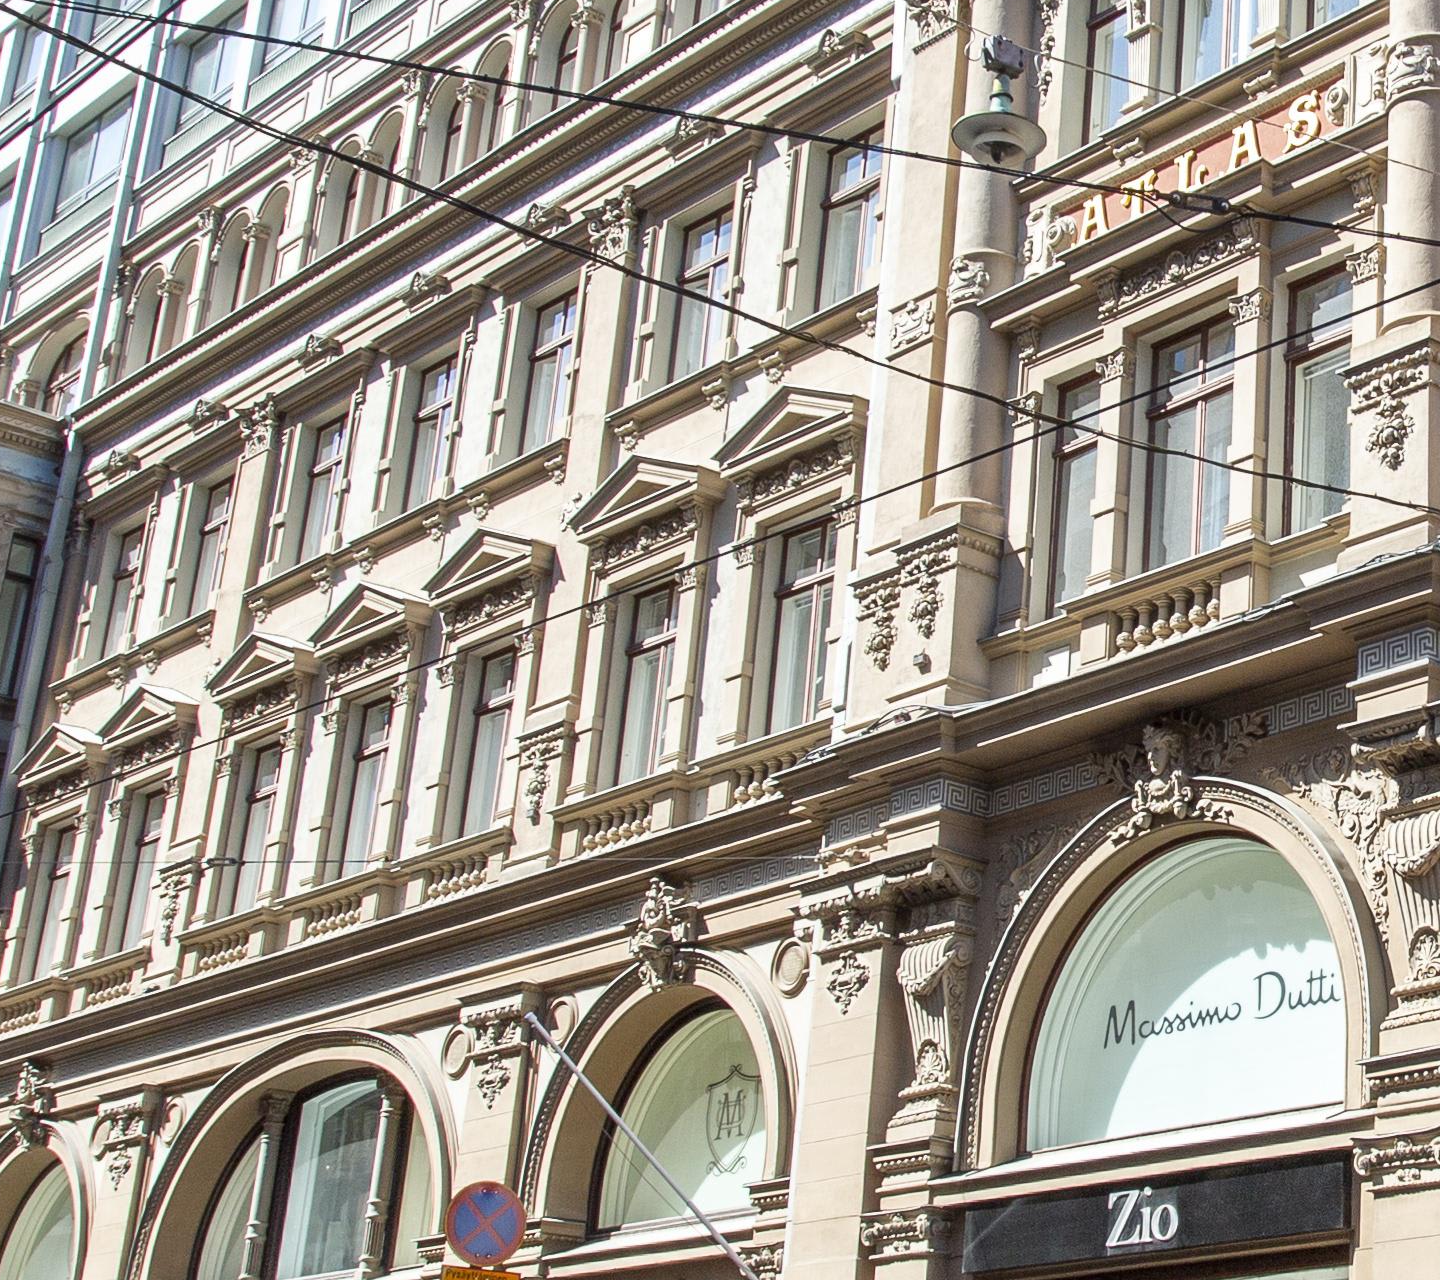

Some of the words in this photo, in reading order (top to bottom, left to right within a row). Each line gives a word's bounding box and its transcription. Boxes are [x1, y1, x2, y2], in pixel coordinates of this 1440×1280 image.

[1071, 89, 1322, 248] ATLAS
[1103, 1000, 1242, 1050] Massimo
[1252, 968, 1341, 1020] Dutti
[1105, 1186, 1180, 1247] Zio
